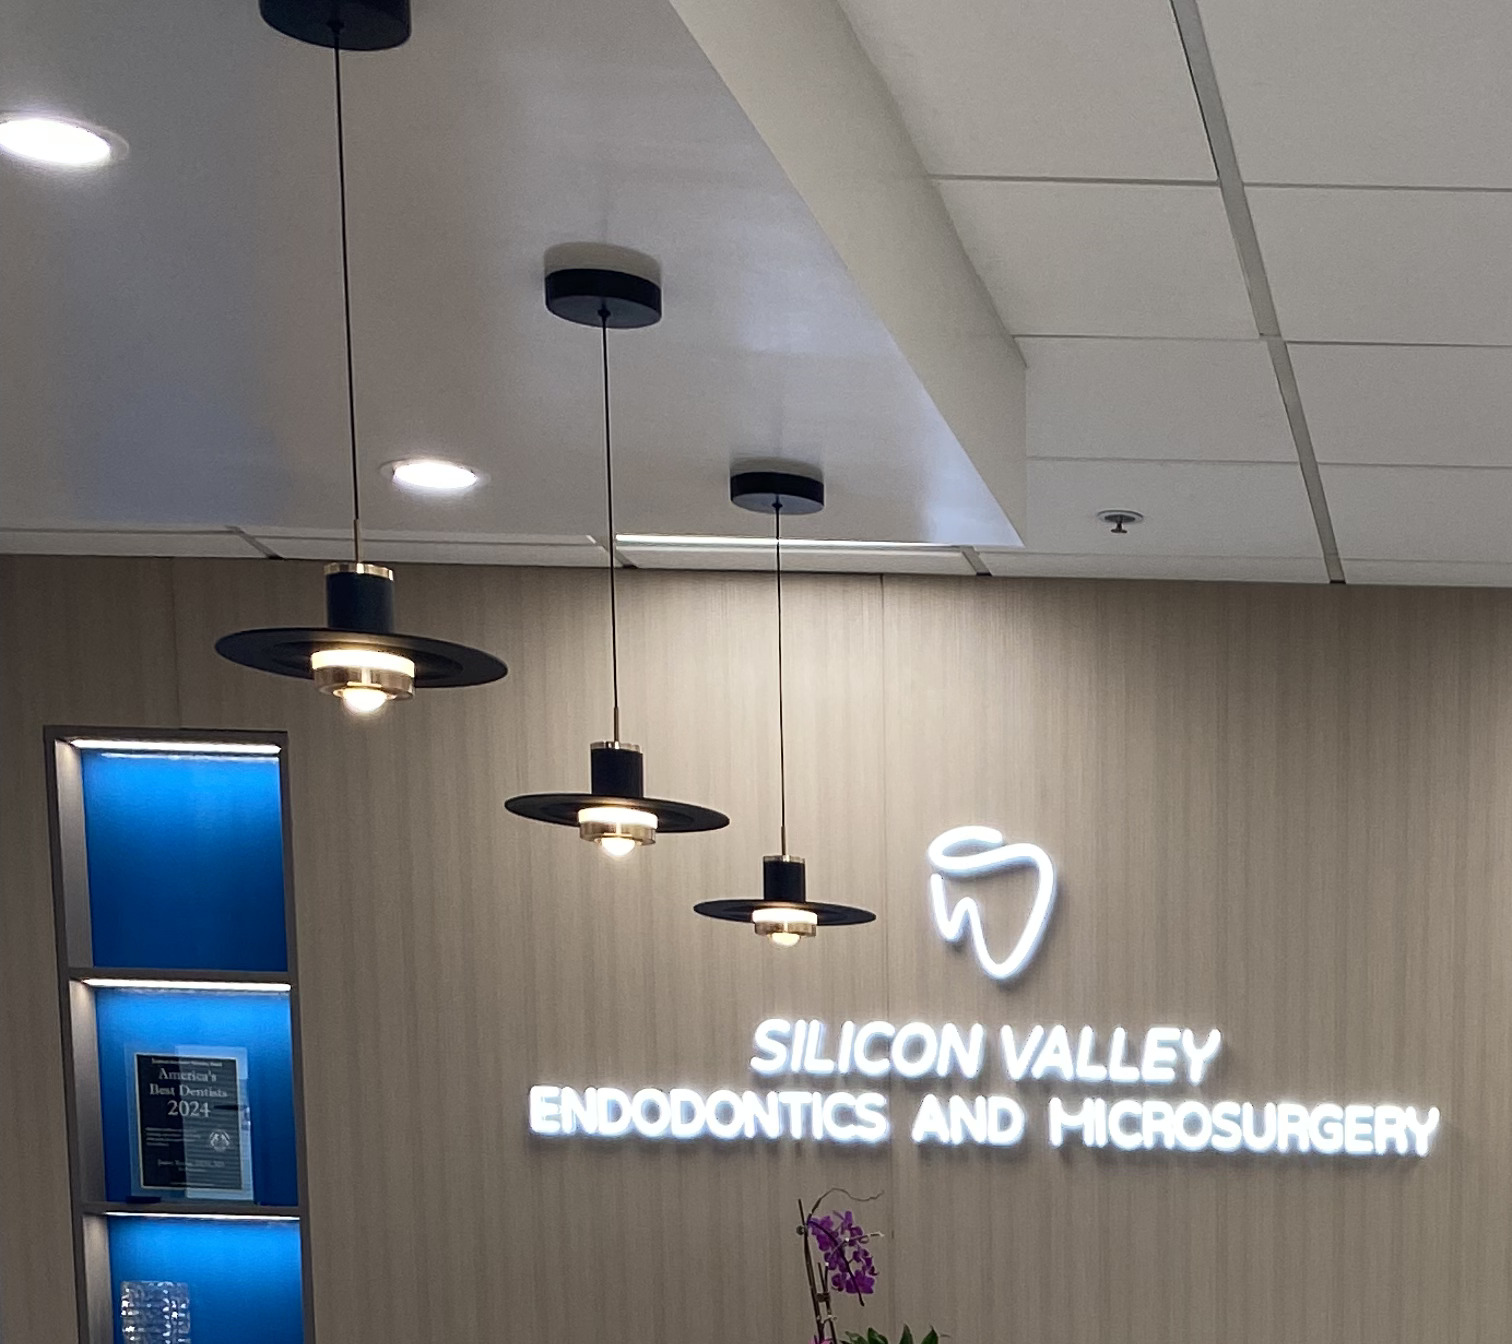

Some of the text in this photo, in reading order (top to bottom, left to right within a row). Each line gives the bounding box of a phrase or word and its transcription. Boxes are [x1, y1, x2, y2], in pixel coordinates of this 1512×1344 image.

[749, 1017, 1221, 1085] SILICON VALLEY
[158, 1067, 217, 1082] America's
[149, 1083, 228, 1098] Best Dentists
[167, 1100, 212, 1117] 2024
[528, 1085, 1440, 1157] ENDODONTICS AND MICROSURGERY
